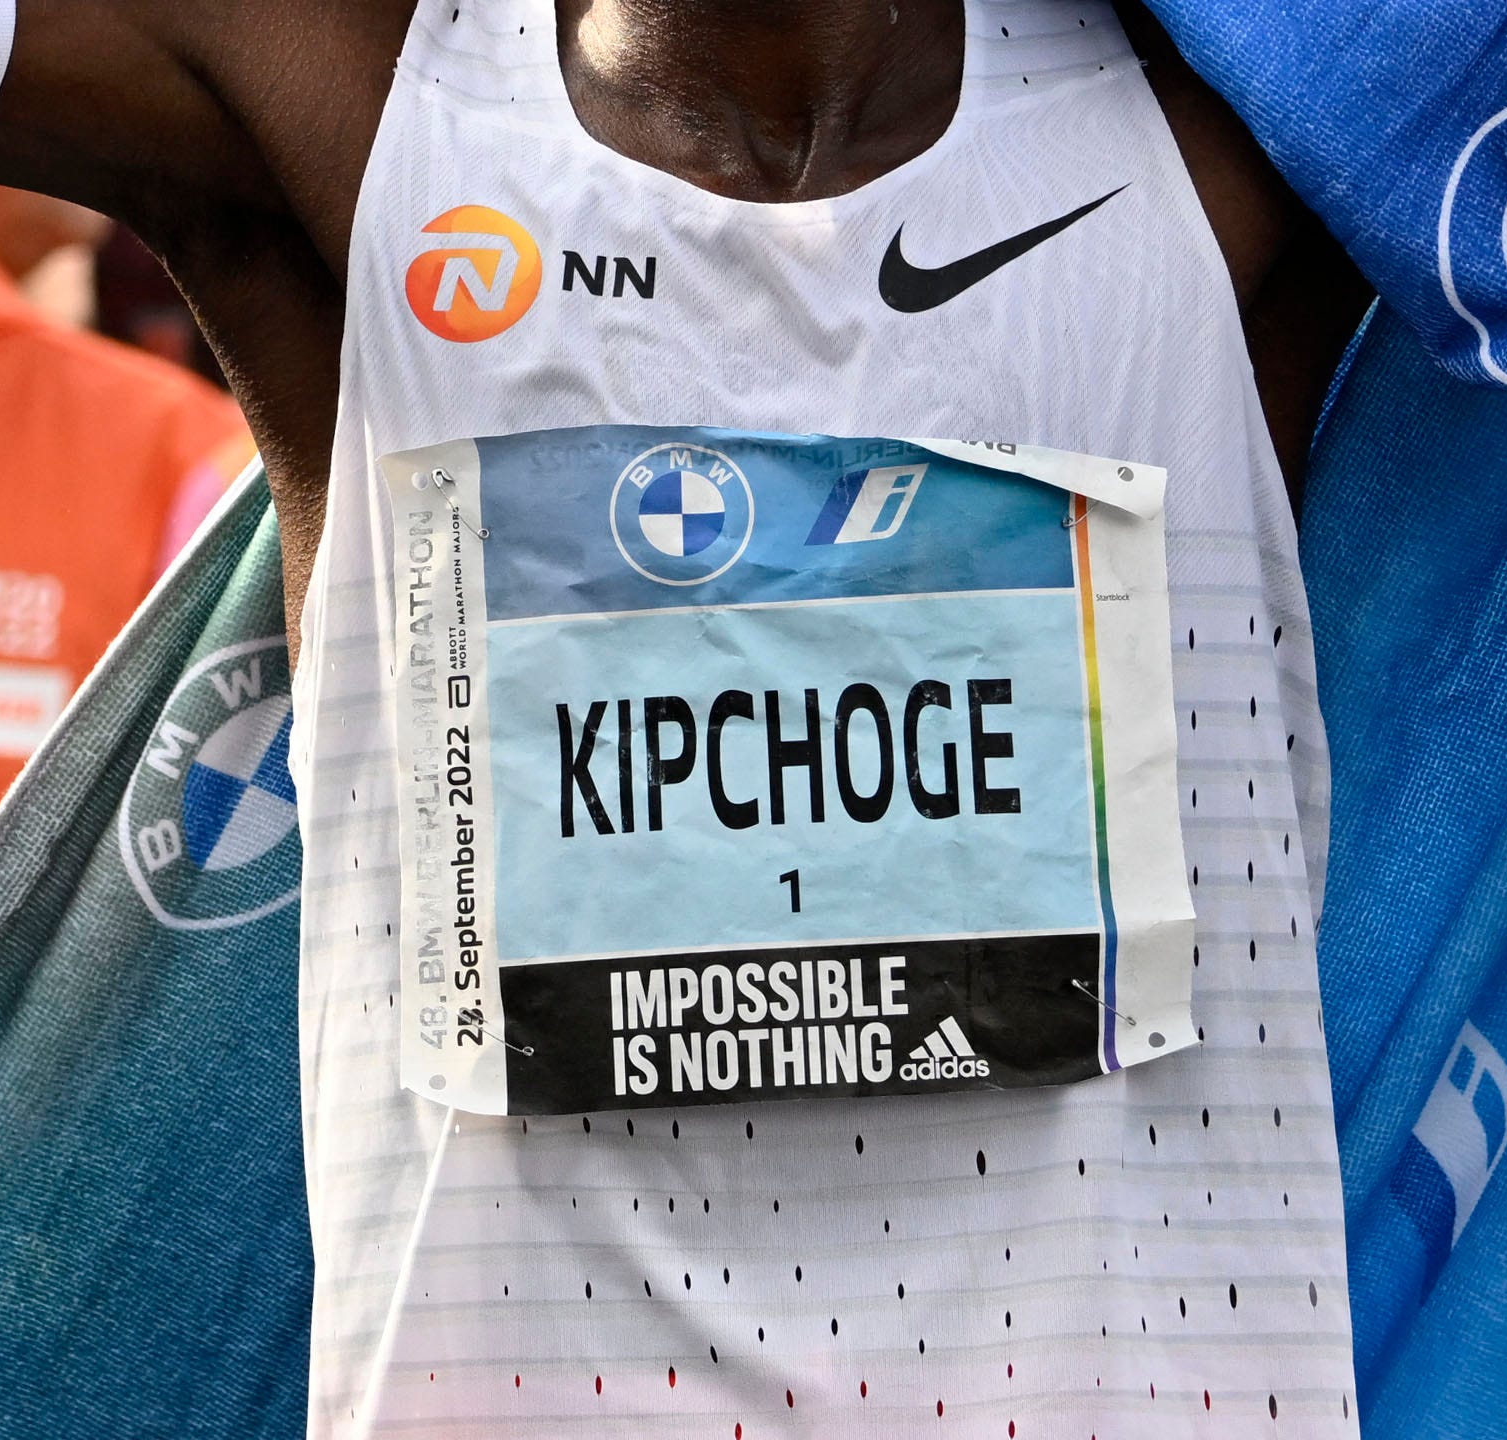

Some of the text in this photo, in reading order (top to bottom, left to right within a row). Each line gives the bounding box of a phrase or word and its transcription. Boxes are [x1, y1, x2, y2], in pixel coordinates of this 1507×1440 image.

[562, 249, 657, 300] NN
[628, 449, 734, 490] BMW
[451, 506, 468, 670] WORLD MARATHON MAJORS
[448, 625, 458, 670] ABBOTT
[137, 659, 263, 875] BMW
[446, 724, 473, 808] 2022
[555, 677, 1021, 839] KIPCHOGE
[450, 813, 484, 991] September
[778, 868, 801, 914] 1
[609, 954, 910, 1032] IMPOSSIBLE
[611, 1020, 894, 1097] IS NOTHING
[898, 1054, 991, 1082] adidas
